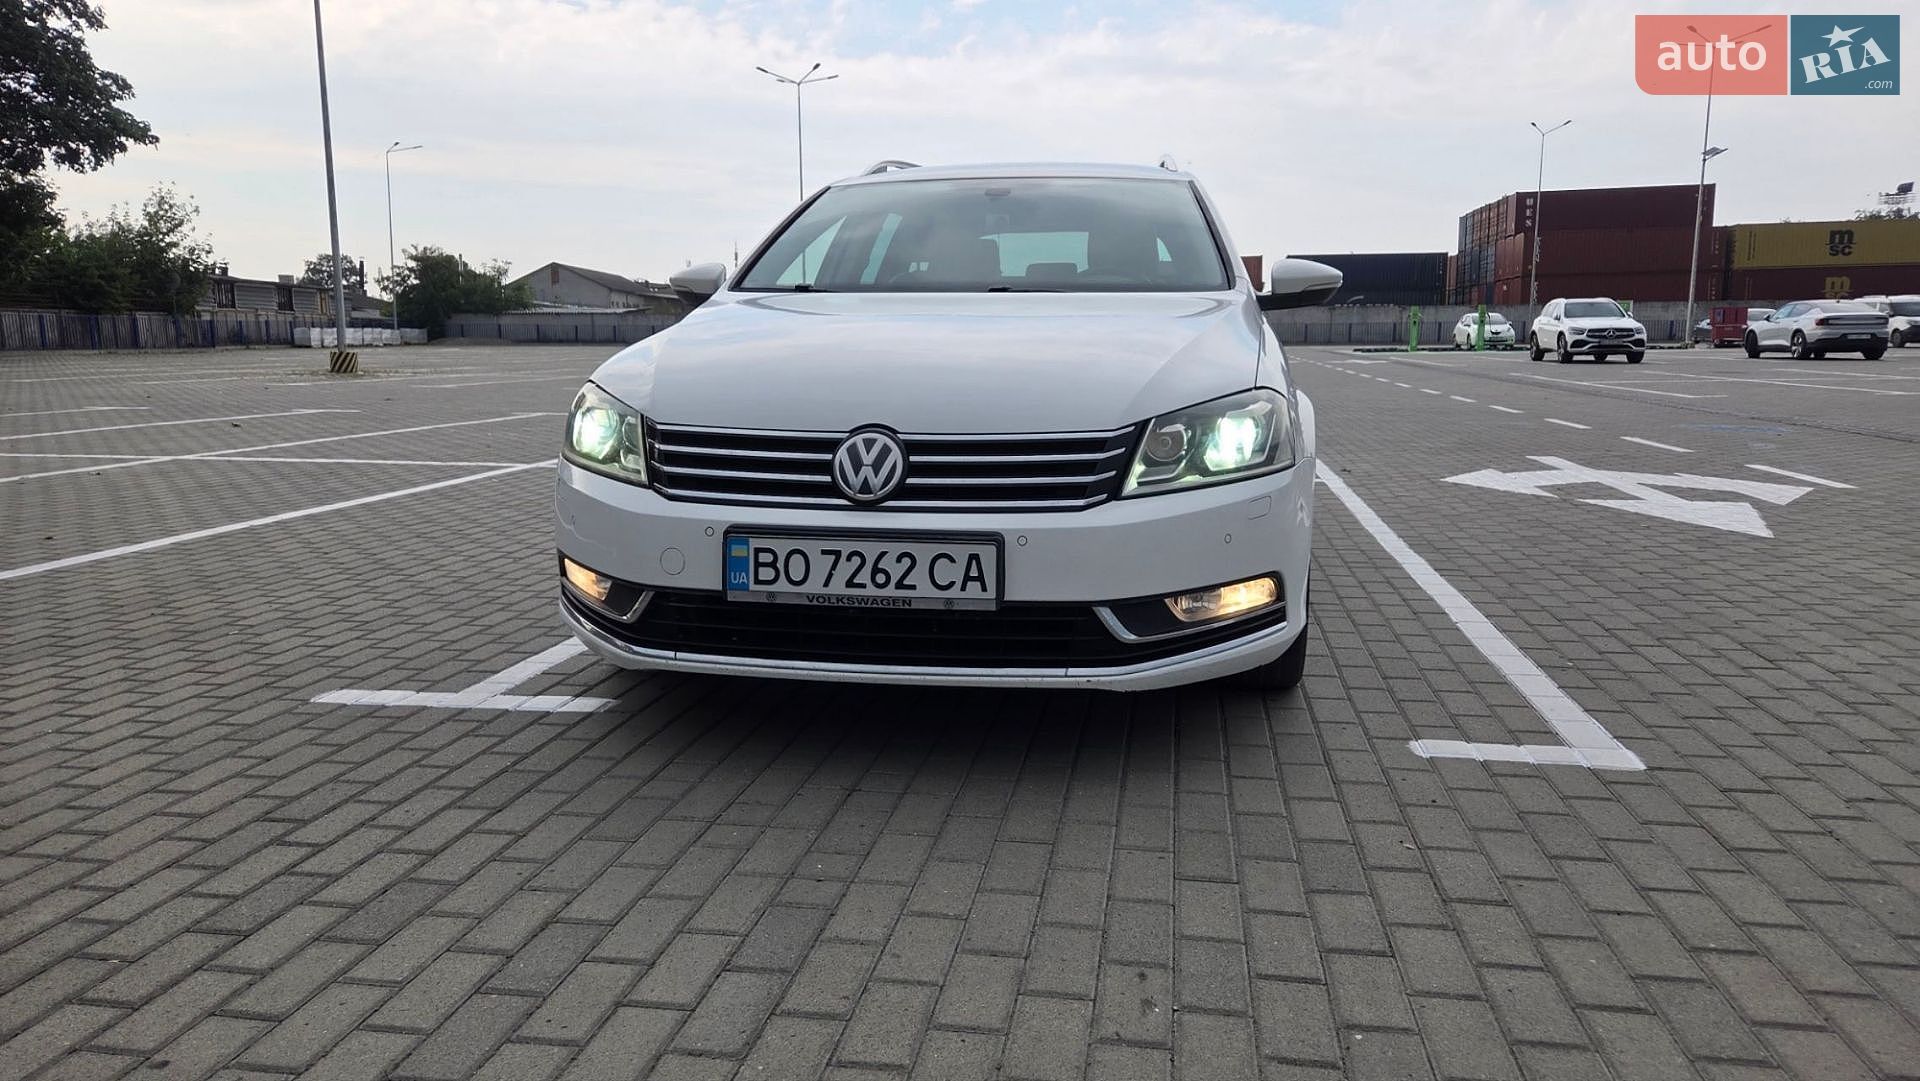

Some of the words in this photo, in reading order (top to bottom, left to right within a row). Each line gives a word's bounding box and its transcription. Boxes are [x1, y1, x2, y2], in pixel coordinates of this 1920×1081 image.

[753, 547, 811, 587] BO
[820, 549, 917, 591] 7262
[928, 552, 988, 593] CA
[731, 571, 748, 585] UA
[806, 595, 912, 608] VOLKSWAGEN
